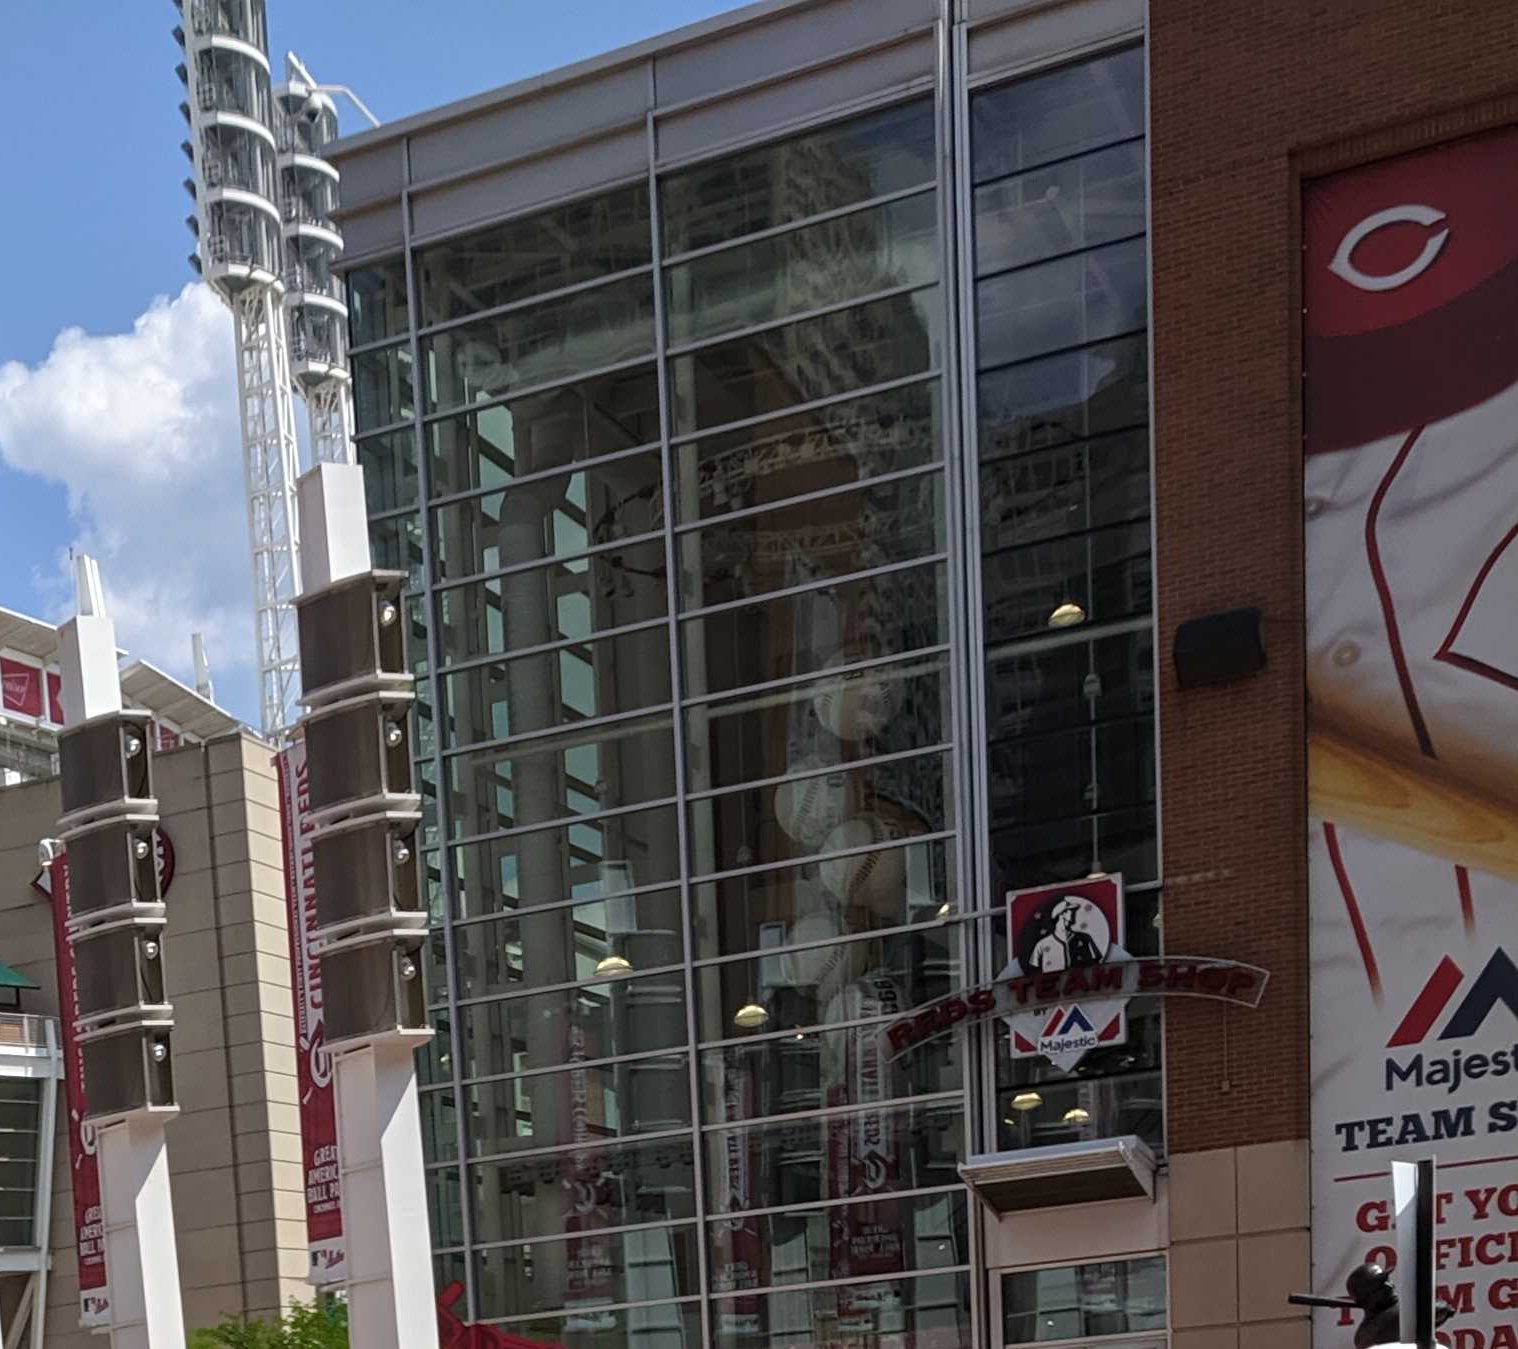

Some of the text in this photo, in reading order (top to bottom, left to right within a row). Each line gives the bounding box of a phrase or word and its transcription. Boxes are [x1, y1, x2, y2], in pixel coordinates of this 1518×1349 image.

[886, 962, 1258, 1053] REDS TEAM SHOP
[1039, 1033, 1097, 1056] Majestic
[1335, 1105, 1476, 1152] TEAM
[1355, 1192, 1454, 1233] GT
